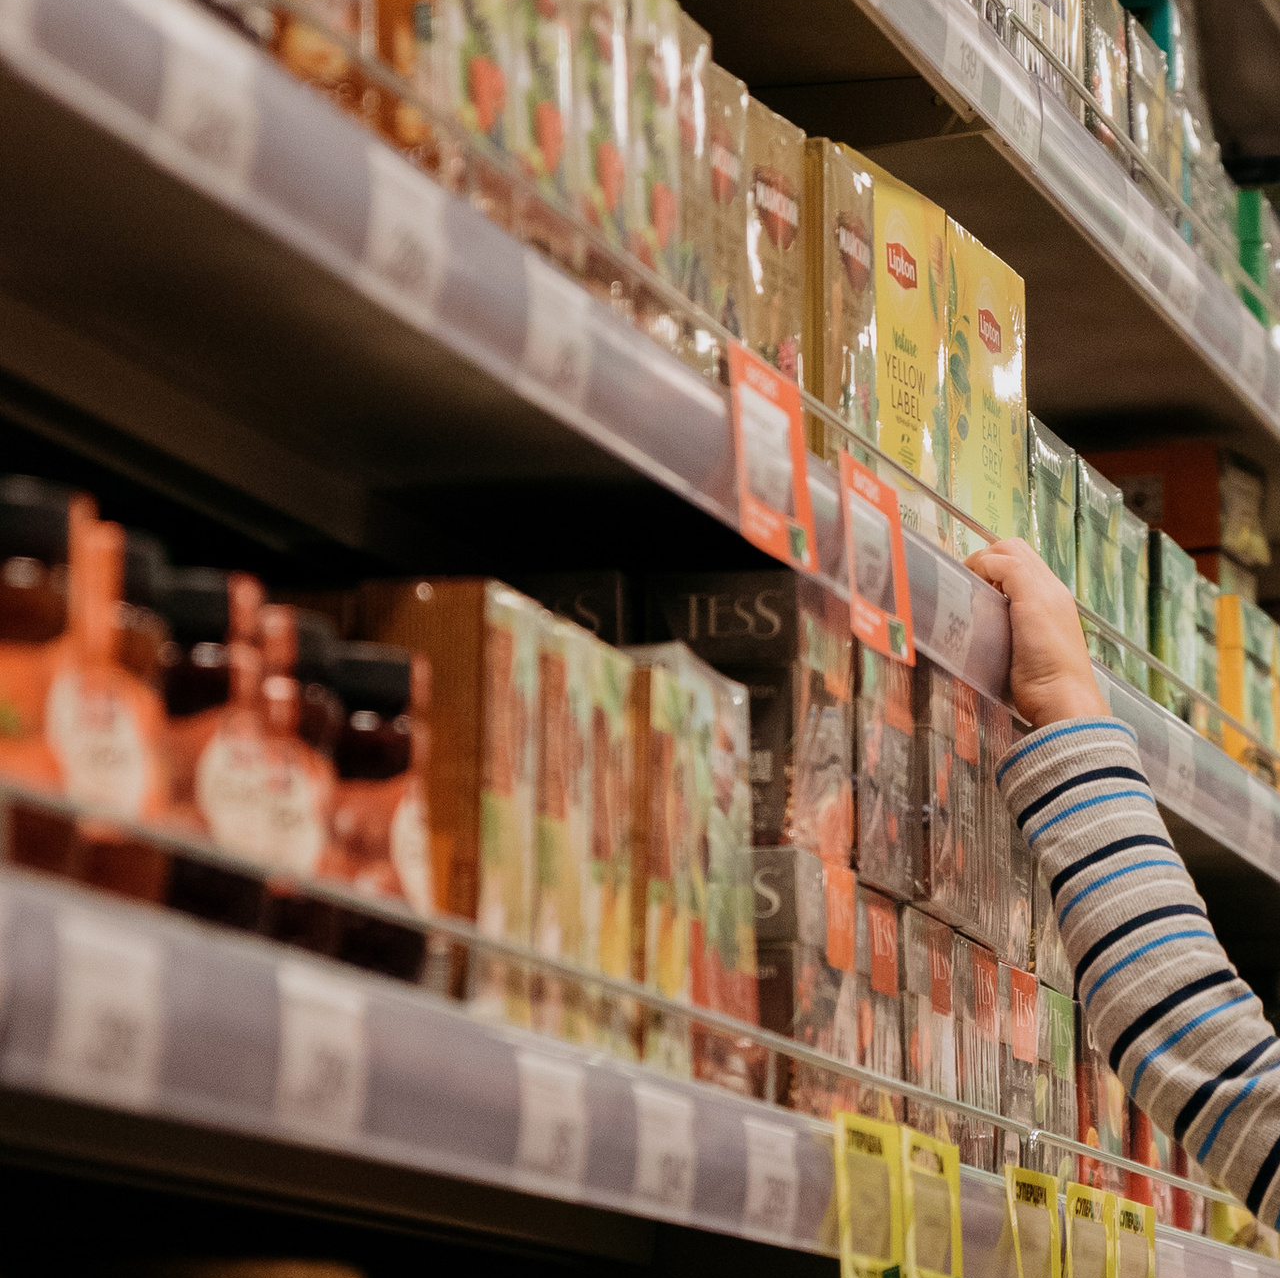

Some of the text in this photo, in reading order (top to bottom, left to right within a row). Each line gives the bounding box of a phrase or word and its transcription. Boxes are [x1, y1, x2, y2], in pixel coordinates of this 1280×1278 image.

[888, 247, 916, 282] Lipton
[980, 314, 1001, 348] Lipton
[884, 350, 927, 398] YELLOW
[890, 382, 922, 423] LABEL
[982, 414, 1003, 451] EARL
[982, 444, 1004, 479] GREY
[682, 588, 783, 640] TESS
[870, 910, 896, 964] TESS
[1013, 987, 1035, 1033] TESS
